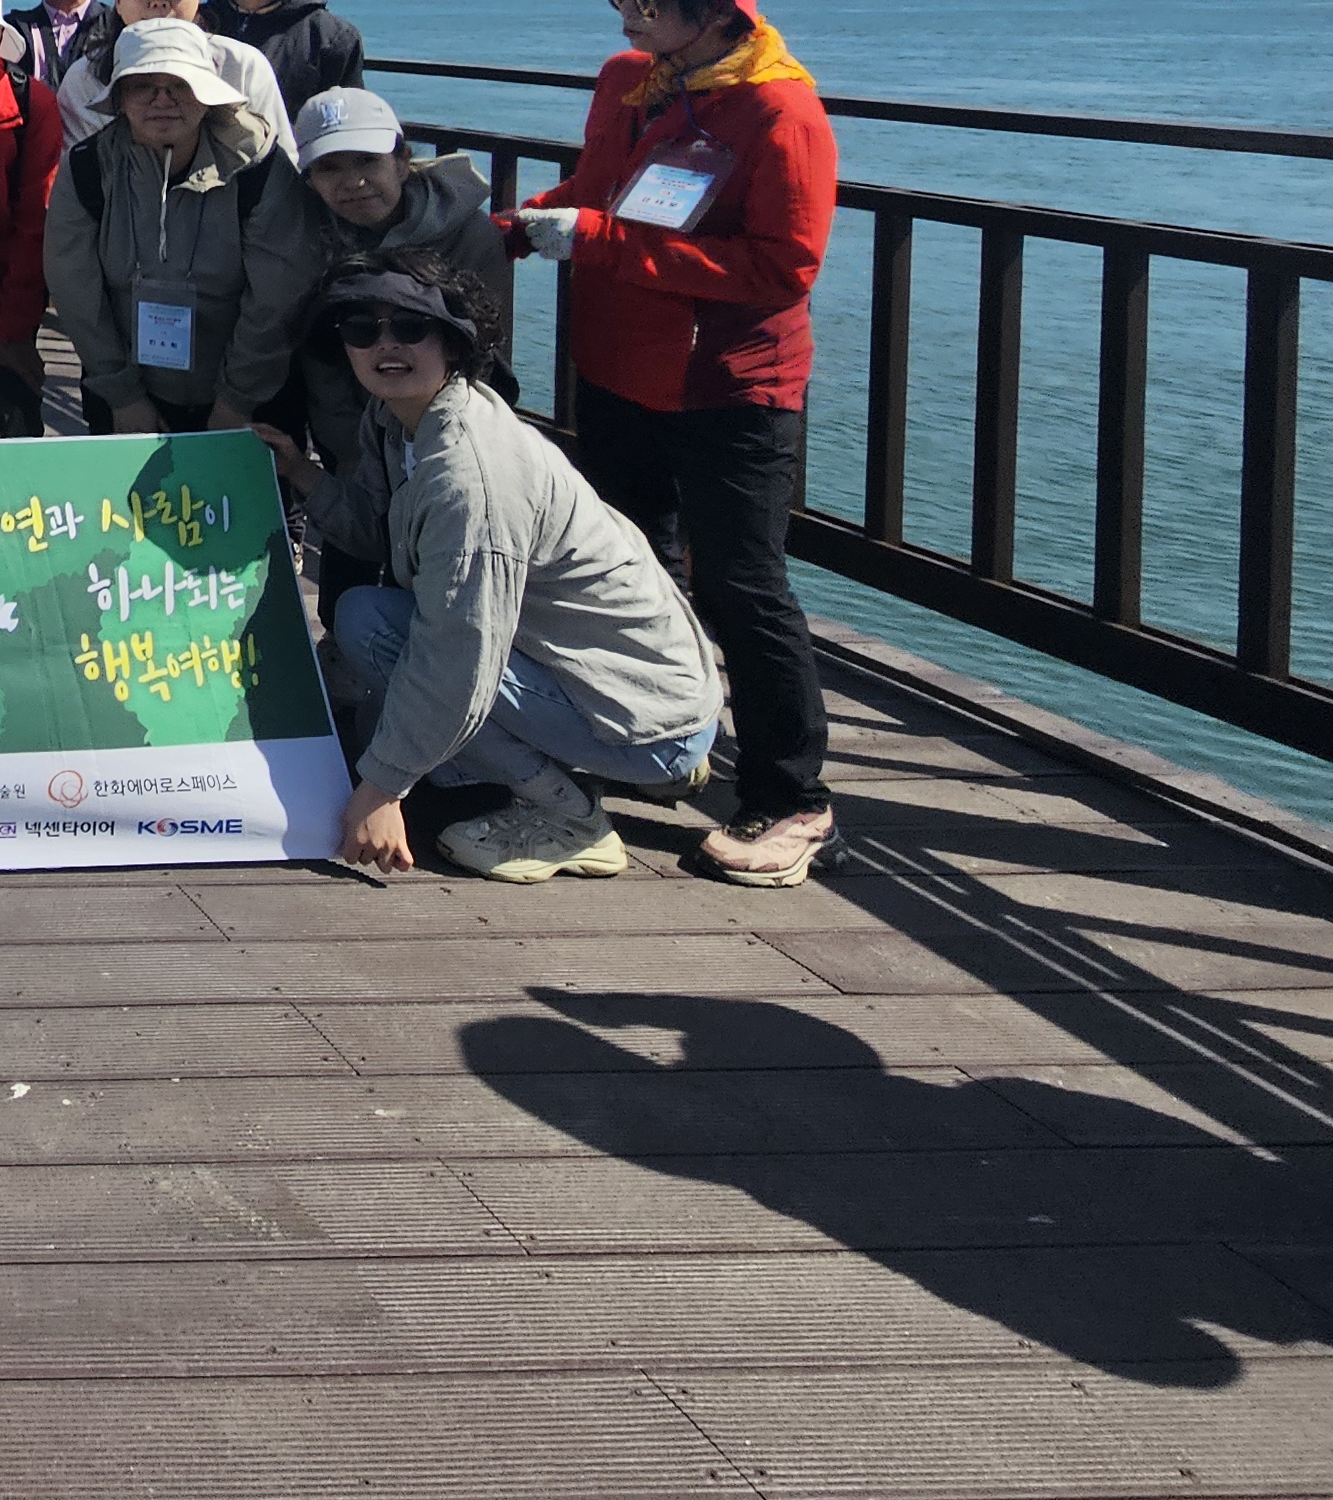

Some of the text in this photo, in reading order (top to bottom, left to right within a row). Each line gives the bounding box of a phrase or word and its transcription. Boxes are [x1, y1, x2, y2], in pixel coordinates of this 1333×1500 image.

[101, 485, 230, 548] 사람이
[87, 560, 245, 622] 하나되는
[74, 630, 260, 702] 행복여행!
[93, 774, 238, 797] 한화에어로스페이스
[24, 819, 116, 838] 넥센타이어
[137, 817, 243, 837] KOSME
